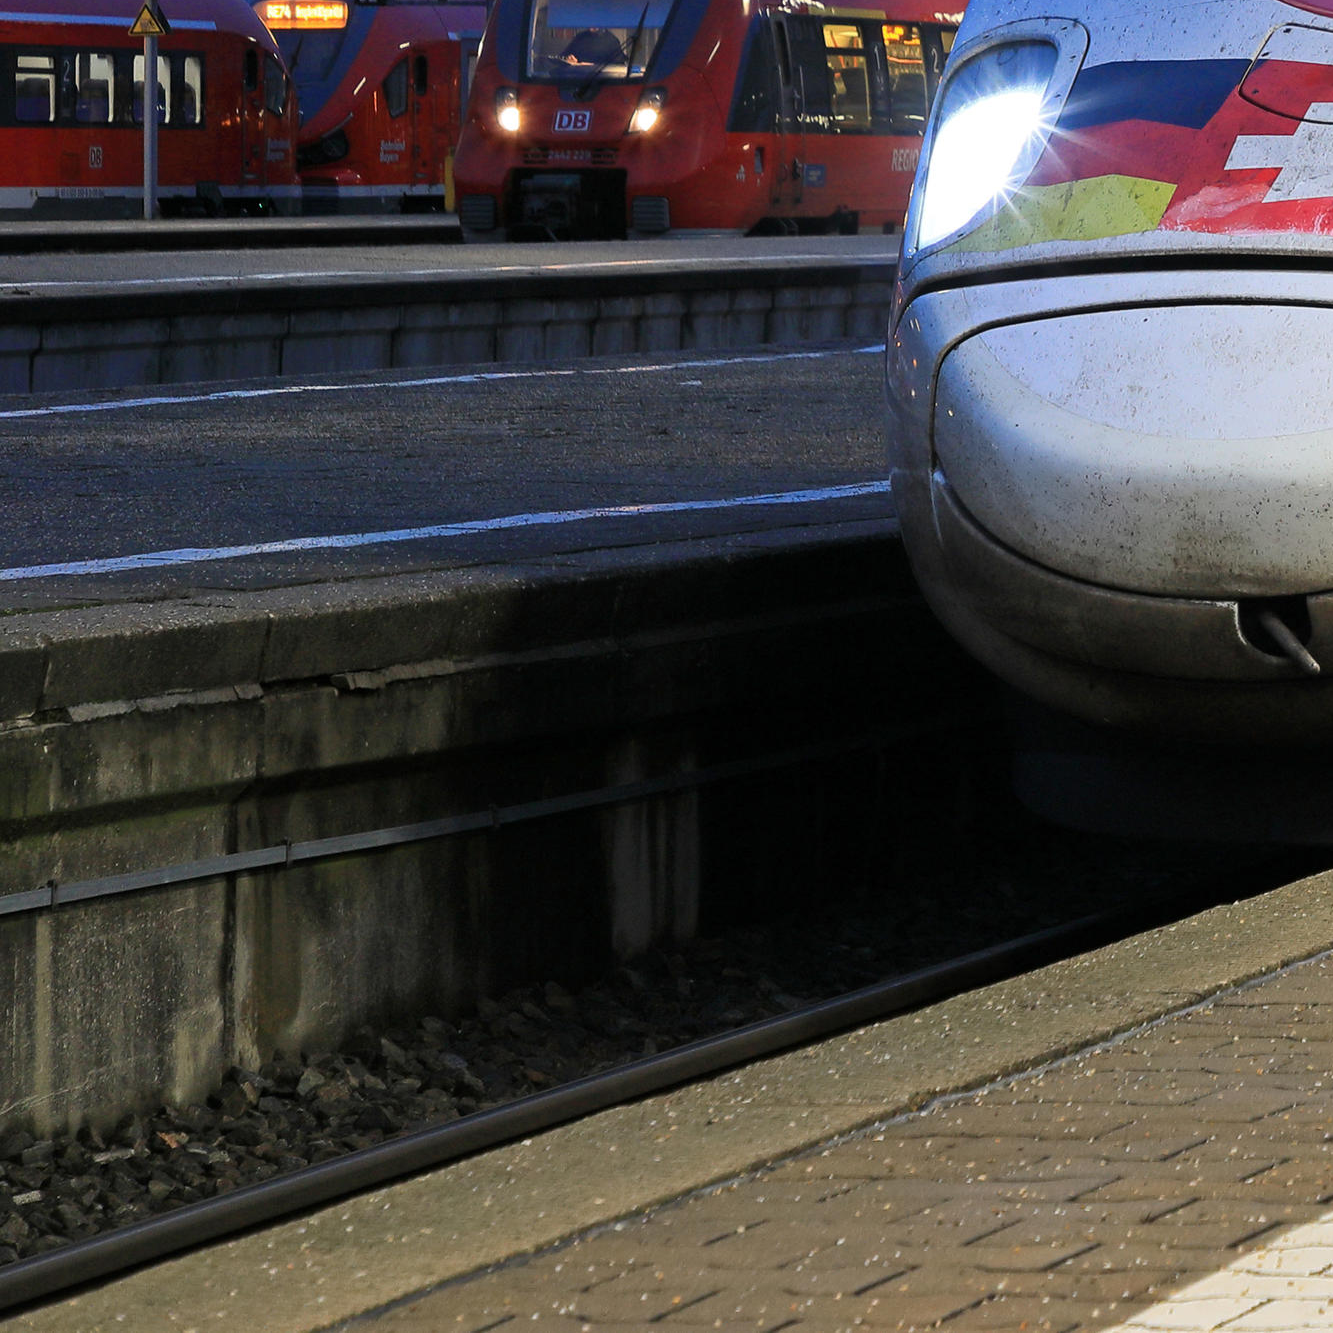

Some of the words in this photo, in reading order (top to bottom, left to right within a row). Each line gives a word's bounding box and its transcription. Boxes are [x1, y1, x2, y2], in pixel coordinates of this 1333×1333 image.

[63, 59, 71, 82] 2
[931, 48, 940, 73] 2
[556, 112, 589, 130] DB
[89, 147, 102, 167] DB
[892, 148, 919, 172] REGIO
